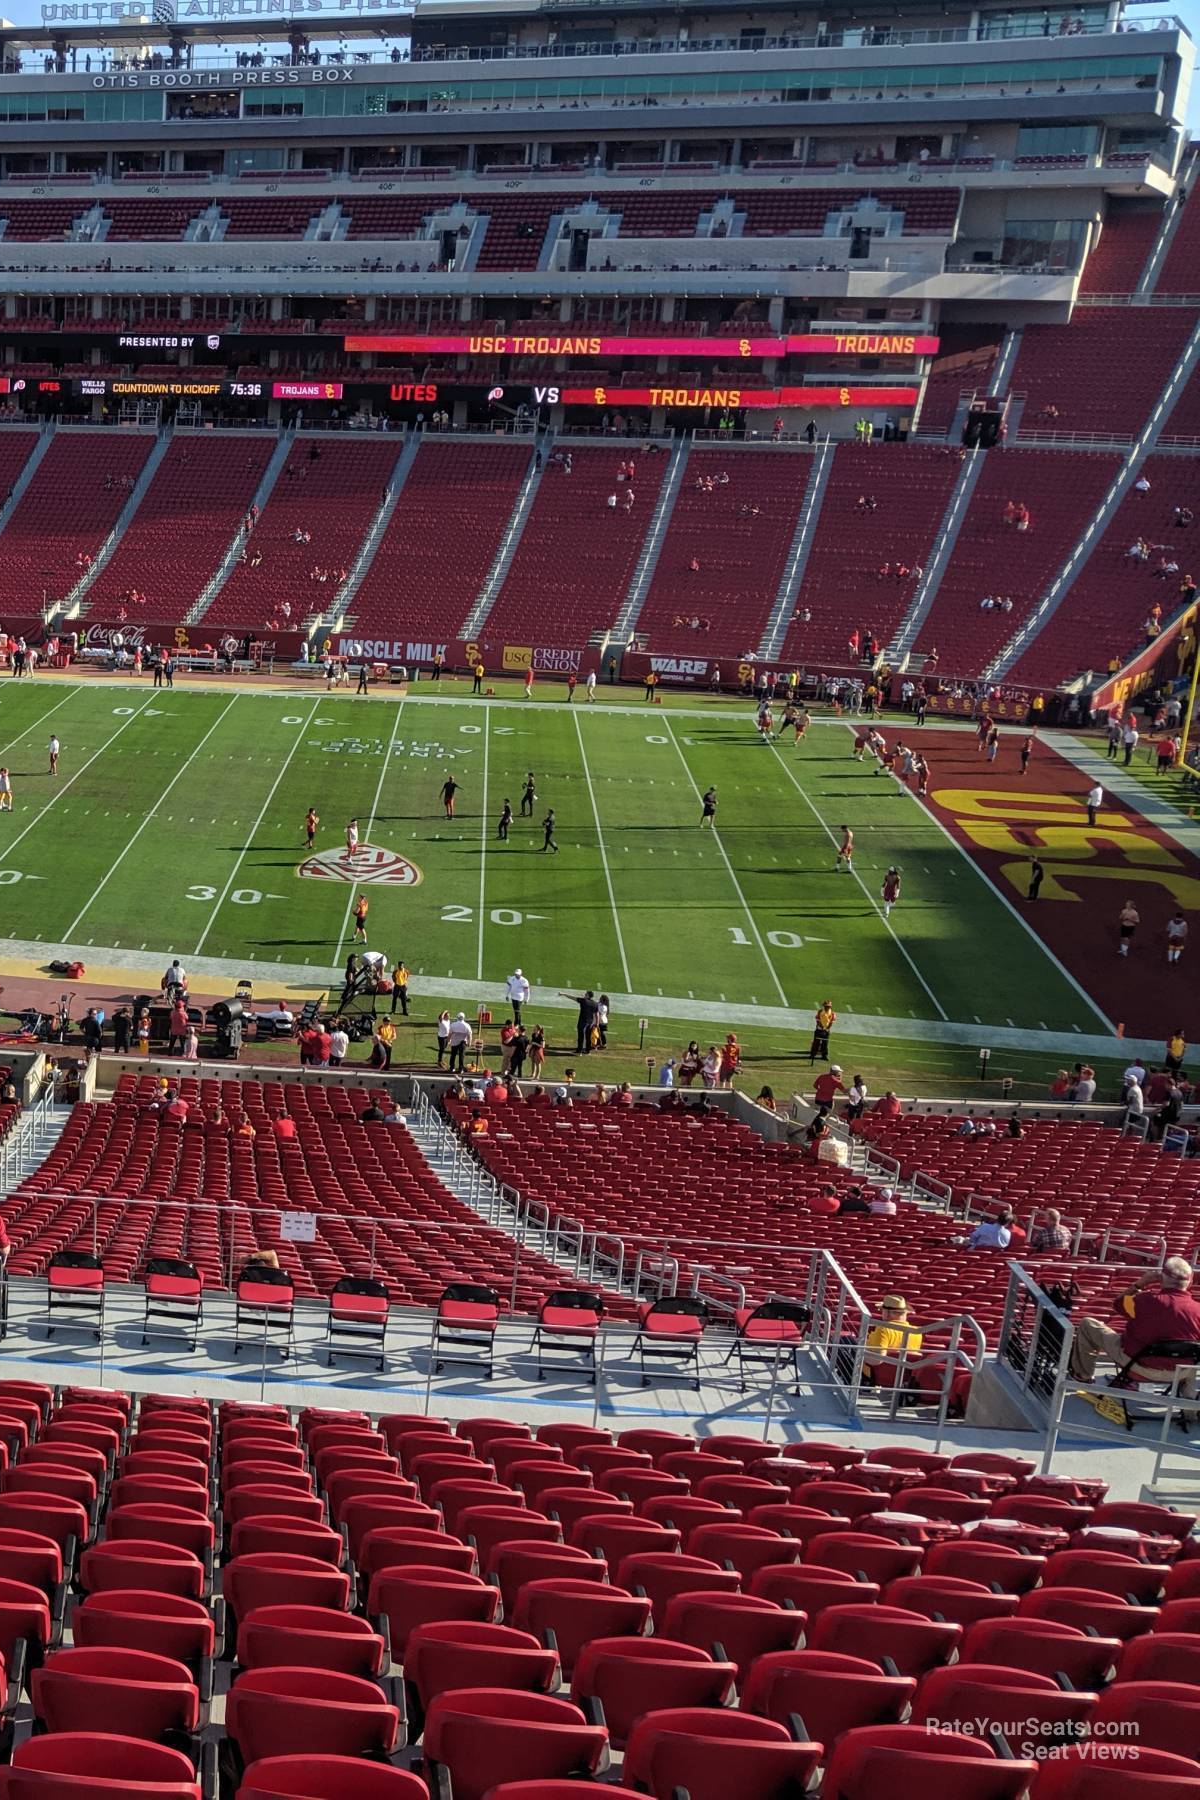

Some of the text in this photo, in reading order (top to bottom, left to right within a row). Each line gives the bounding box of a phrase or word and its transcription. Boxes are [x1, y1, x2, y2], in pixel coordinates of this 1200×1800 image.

[41, 2, 145, 20] UNITED
[185, 0, 323, 16] AIRLINES
[93, 69, 354, 88] OTIS BOOTH PRESS BOX
[119, 337, 194, 347] PRESENTED BY
[469, 337, 601, 355] USC TROJANS
[834, 336, 915, 354] TROJANS
[39, 382, 60, 391] UTES
[113, 383, 221, 395] COUNTDOWN TO KICKOFF
[230, 383, 262, 396] 75:36
[280, 386, 319, 396] TROJANS
[391, 384, 437, 402] UTES
[534, 387, 559, 403] VS
[649, 388, 741, 408] TROJANS
[339, 638, 447, 663] MUSCLE MILK
[504, 652, 532, 664] USC
[533, 647, 584, 661] CREDIT
[533, 659, 581, 672] UNION
[651, 657, 708, 675] WARE
